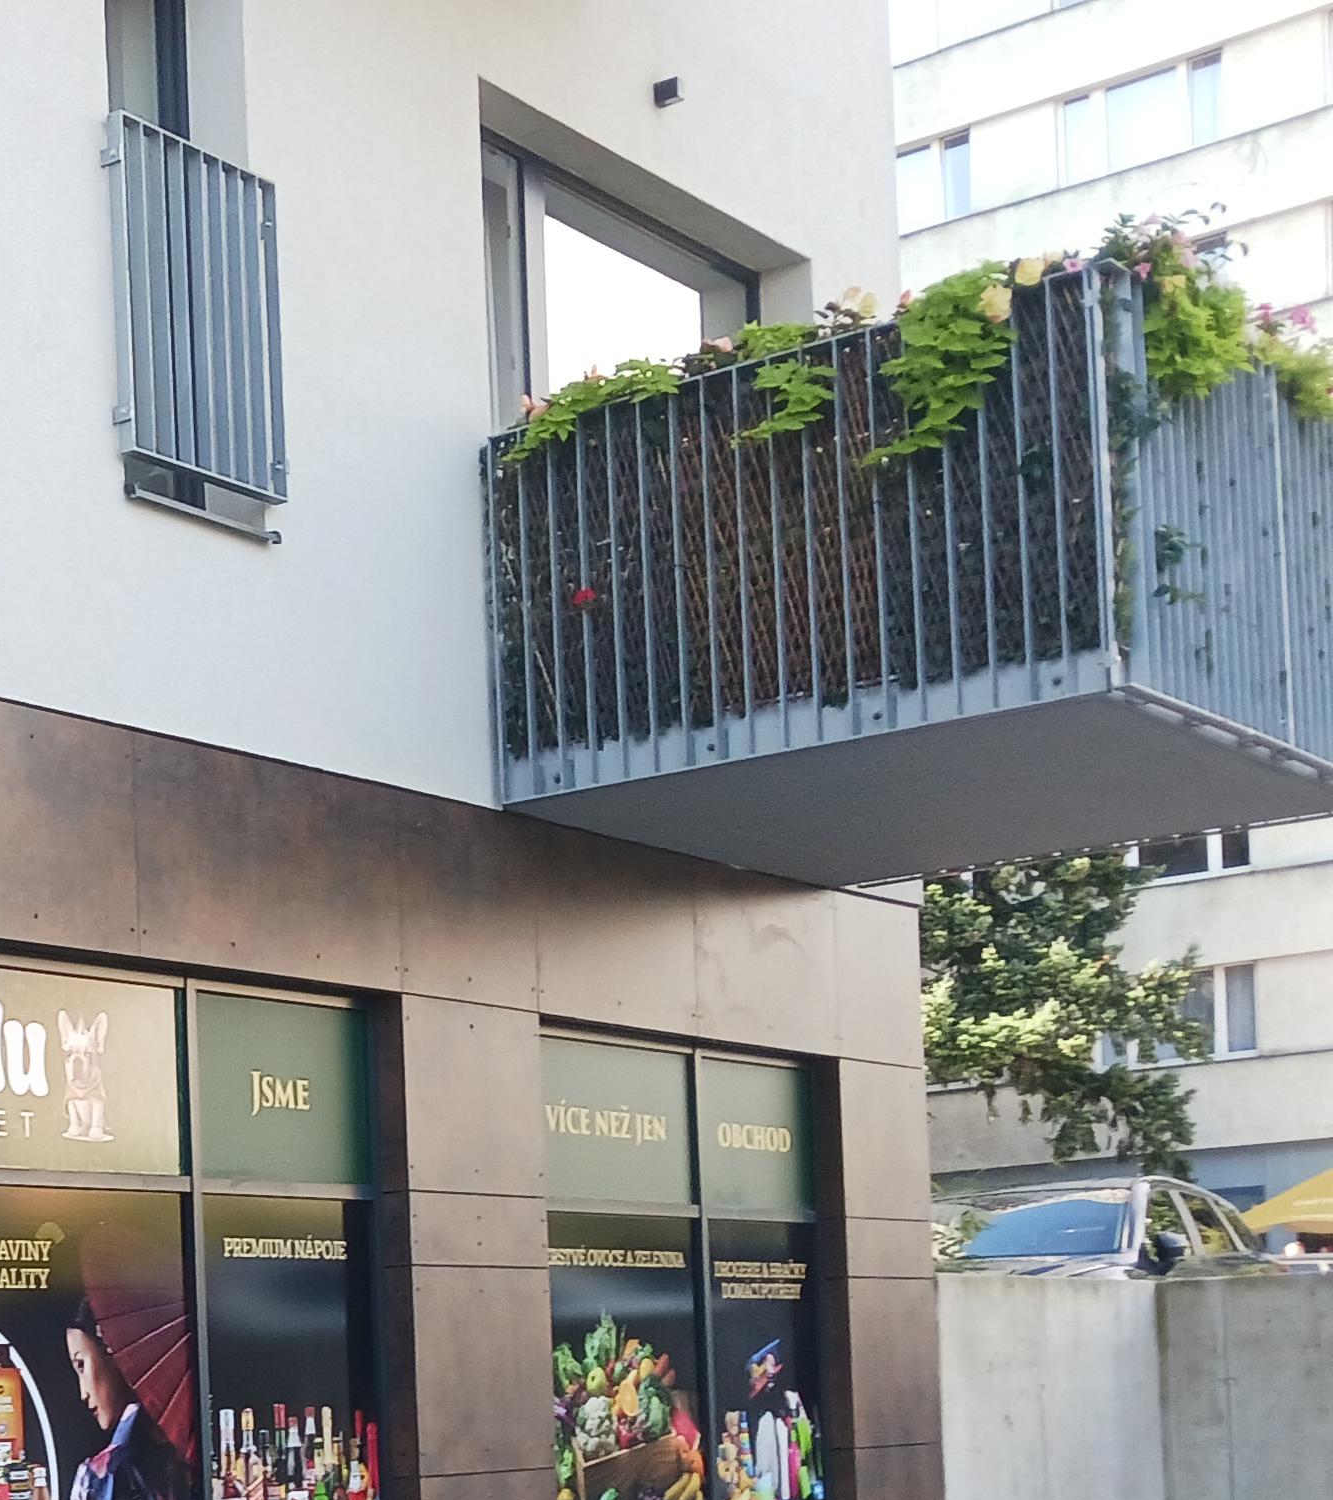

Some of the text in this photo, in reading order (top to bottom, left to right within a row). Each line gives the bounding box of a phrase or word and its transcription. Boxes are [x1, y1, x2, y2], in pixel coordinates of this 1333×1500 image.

[250, 1070, 311, 1116] JSME
[544, 1099, 668, 1146] VÍCE NEŽ JEN
[717, 1121, 793, 1153] OBCHOD
[222, 1237, 294, 1258] PREMIUM
